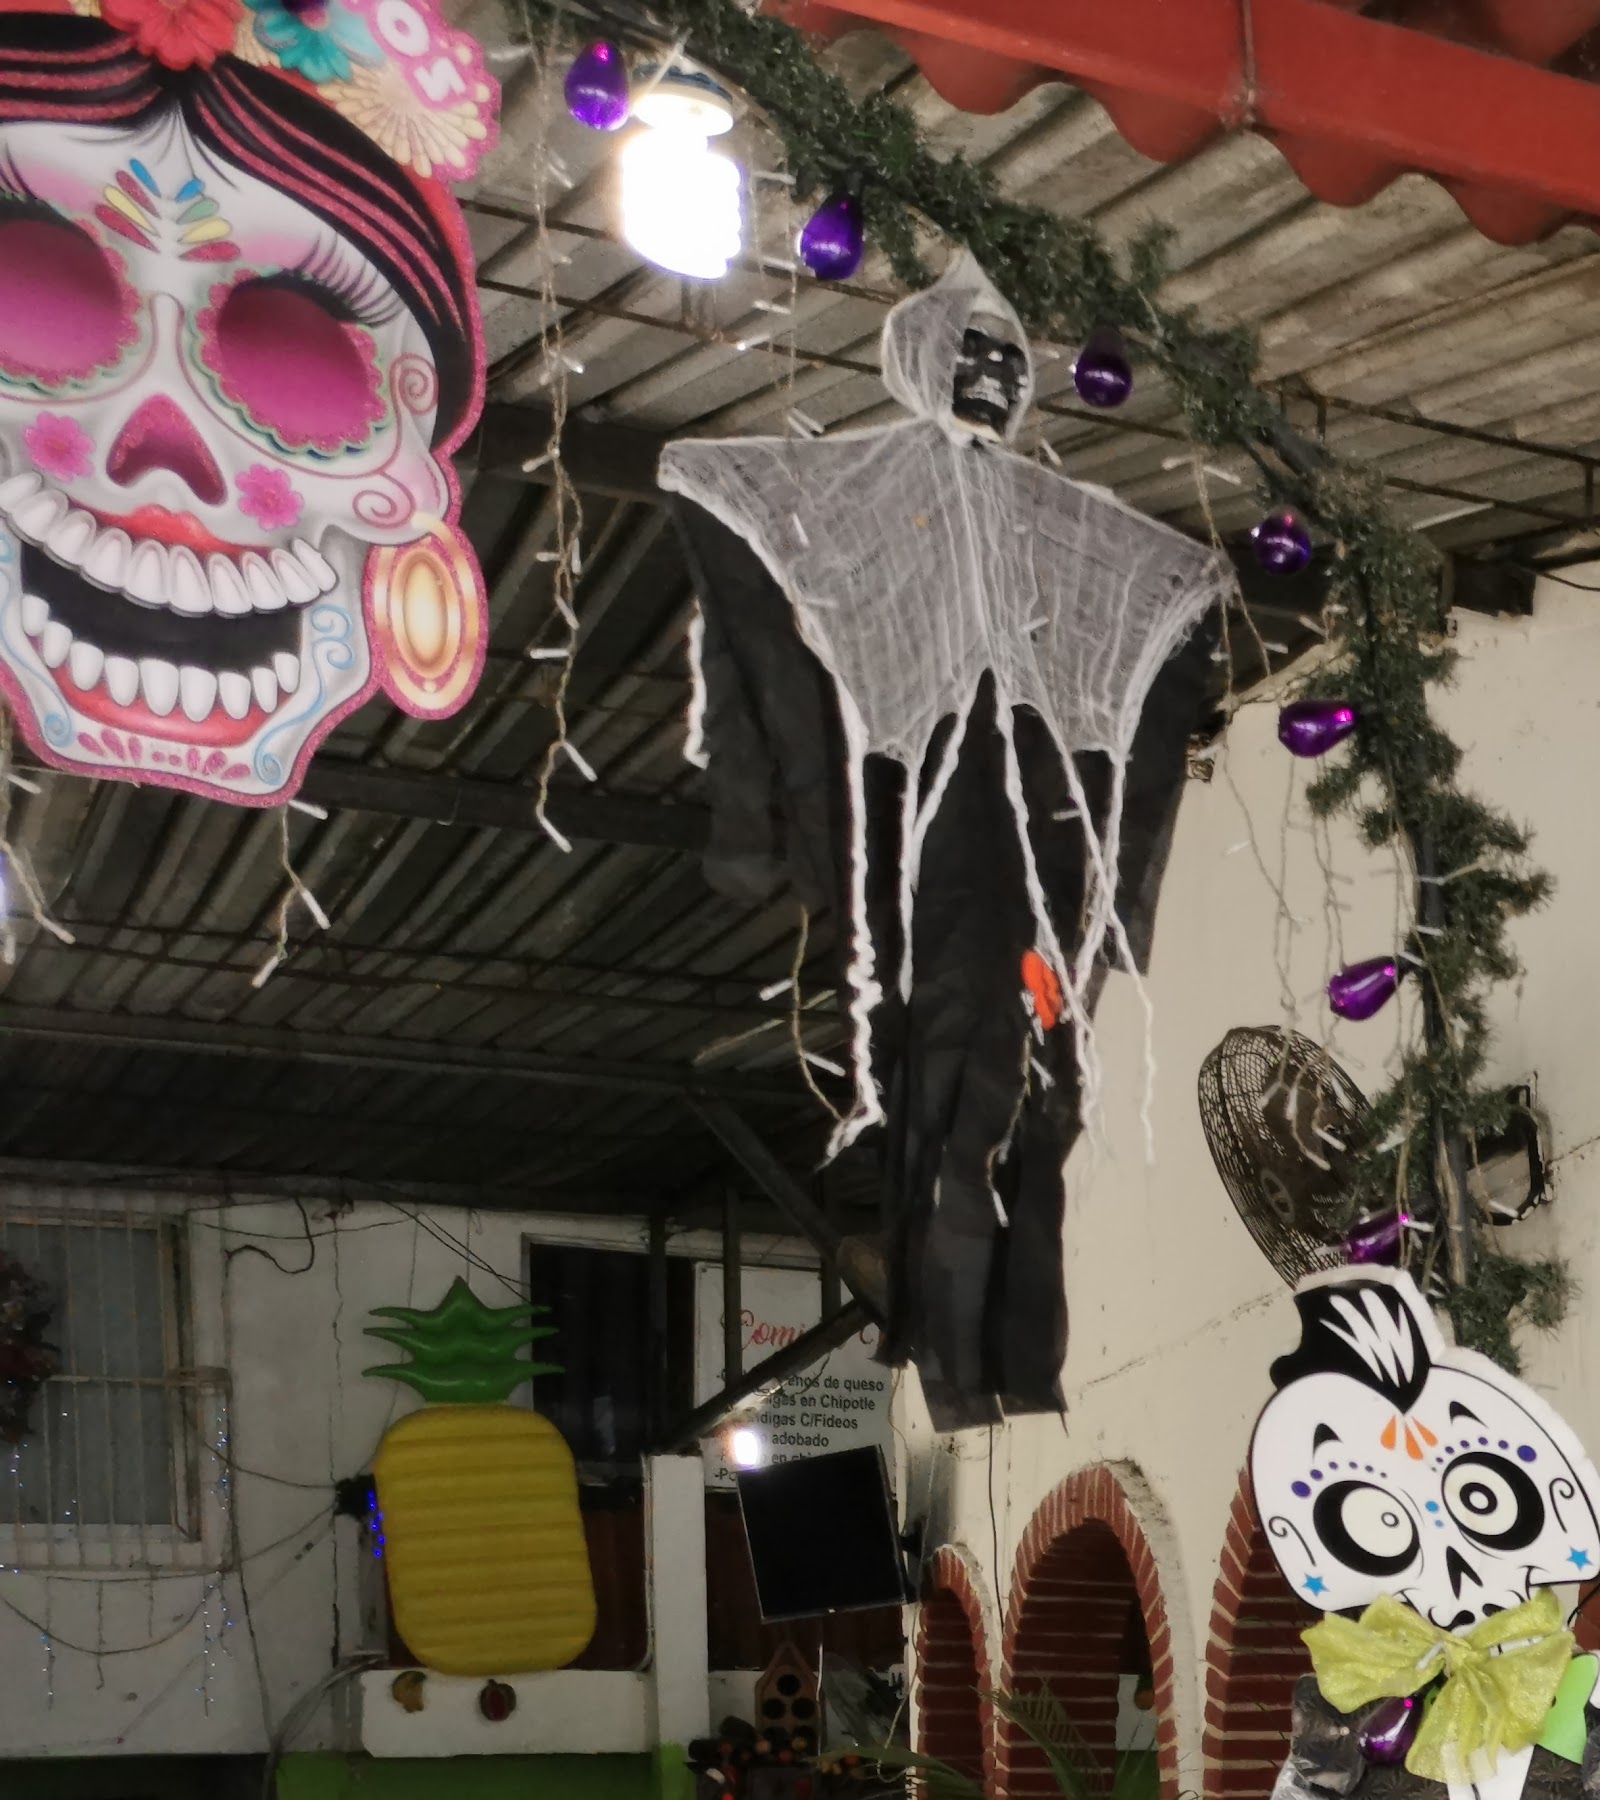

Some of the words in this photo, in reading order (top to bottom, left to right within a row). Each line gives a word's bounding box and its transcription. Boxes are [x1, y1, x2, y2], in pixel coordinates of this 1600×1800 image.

[824, 1376, 840, 1390] de
[843, 1378, 884, 1393] queso
[820, 1395, 876, 1413] Chipotle
[800, 1413, 858, 1430] C/Fideos
[772, 1433, 830, 1448] adobado
